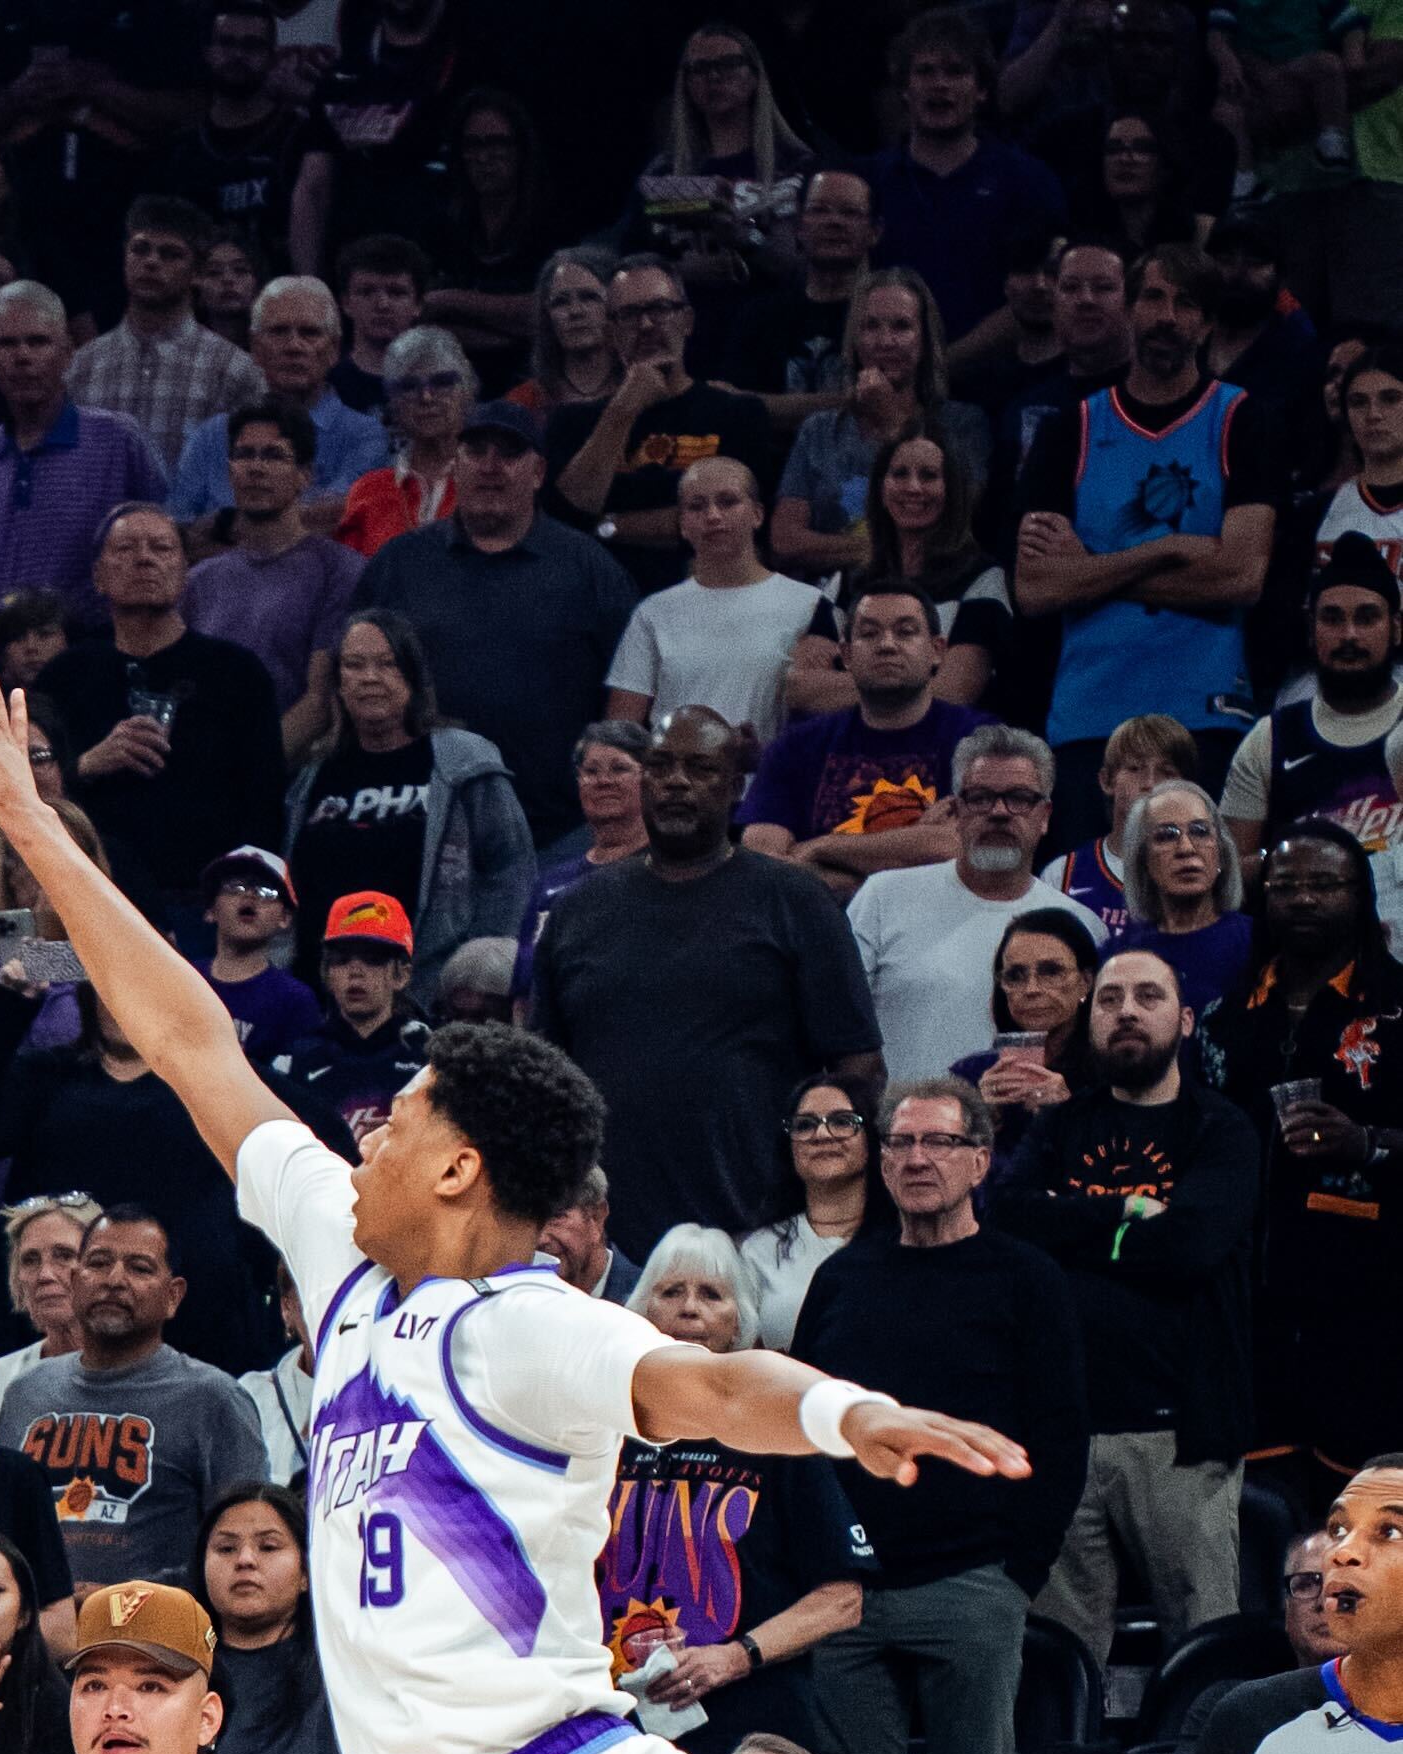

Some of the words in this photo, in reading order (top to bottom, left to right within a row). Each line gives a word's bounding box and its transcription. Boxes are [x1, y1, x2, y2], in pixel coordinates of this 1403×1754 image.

[680, 1462, 764, 1486] AYOFFS
[100, 1503, 118, 1520] AZ
[358, 1510, 411, 1608] 19
[609, 1480, 760, 1637] UNS
